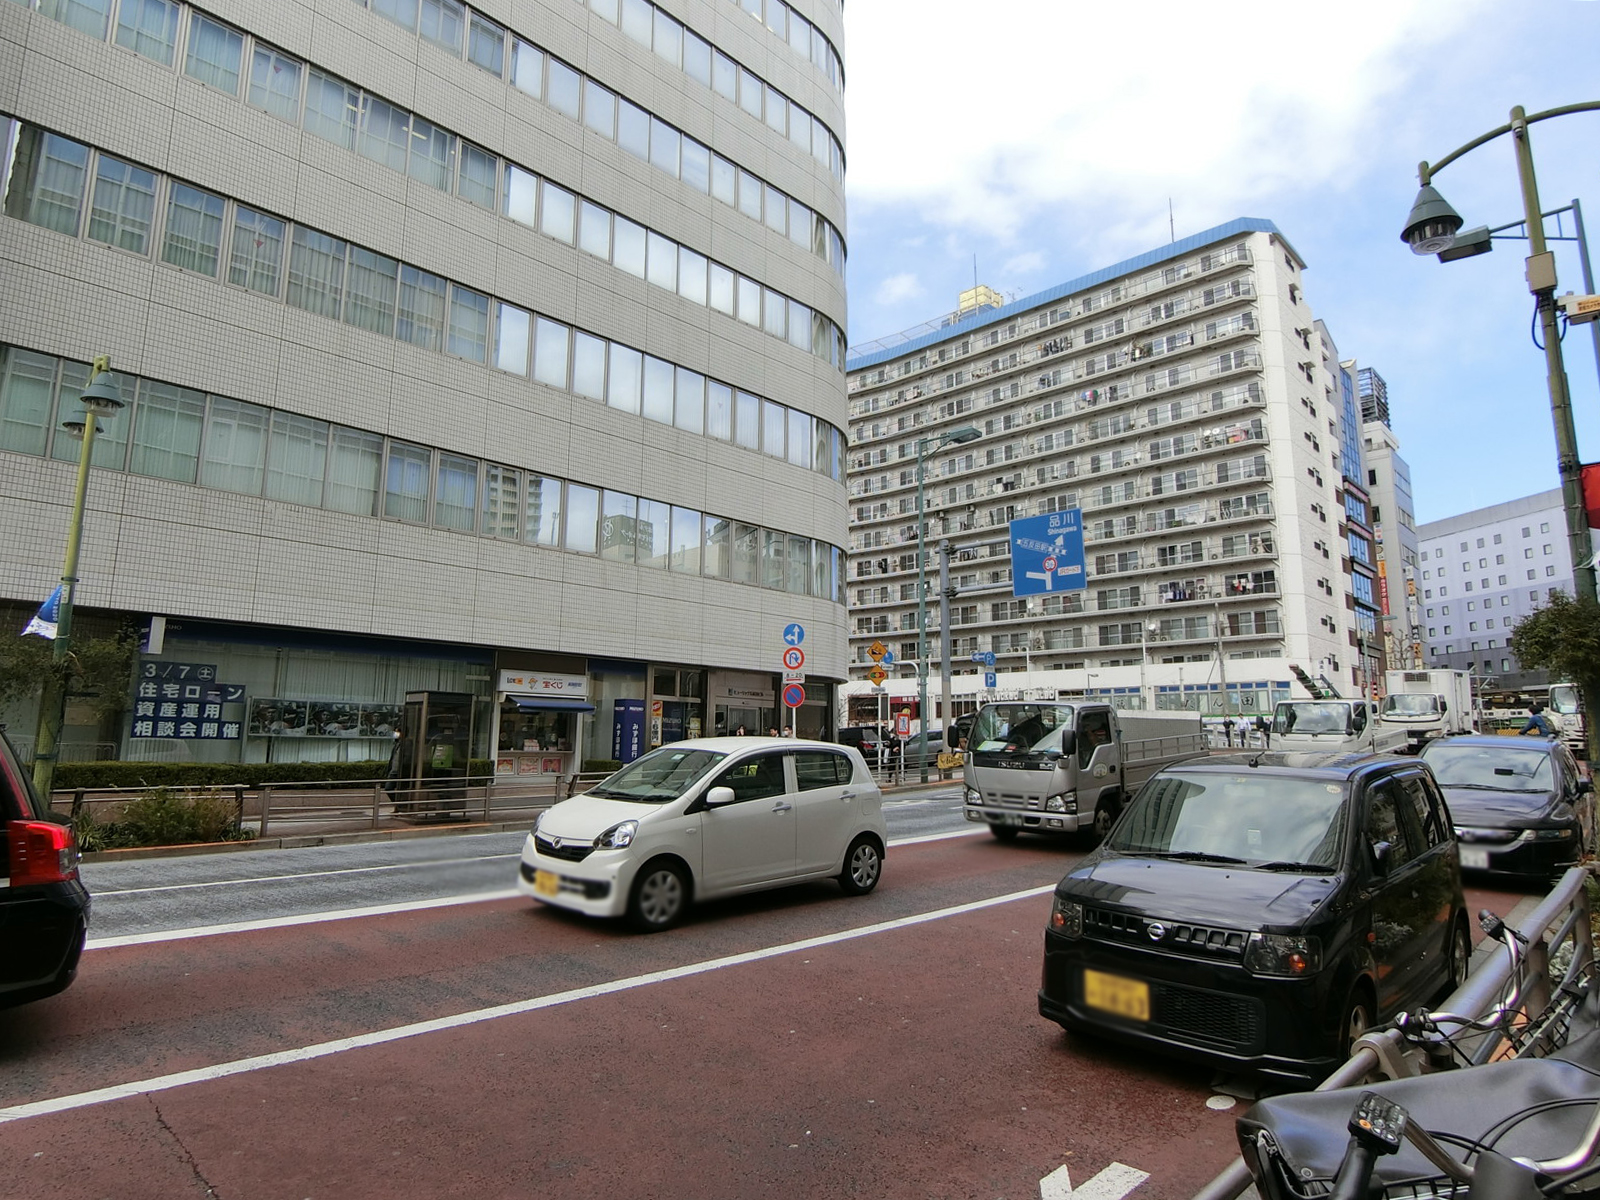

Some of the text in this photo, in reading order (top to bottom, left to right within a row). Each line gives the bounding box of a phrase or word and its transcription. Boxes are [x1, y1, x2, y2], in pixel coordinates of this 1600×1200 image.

[1050, 512, 1074, 527] 品川
[1047, 526, 1077, 536] Shinagawa
[542, 680, 563, 689] 宝くじ
[987, 674, 995, 686] P
[139, 682, 243, 700] 住宅ローン
[136, 701, 221, 719] 資産運用
[134, 721, 240, 738] 相談会開催
[631, 723, 639, 758] みずほ銀行
[998, 761, 1026, 769] ISUZU
